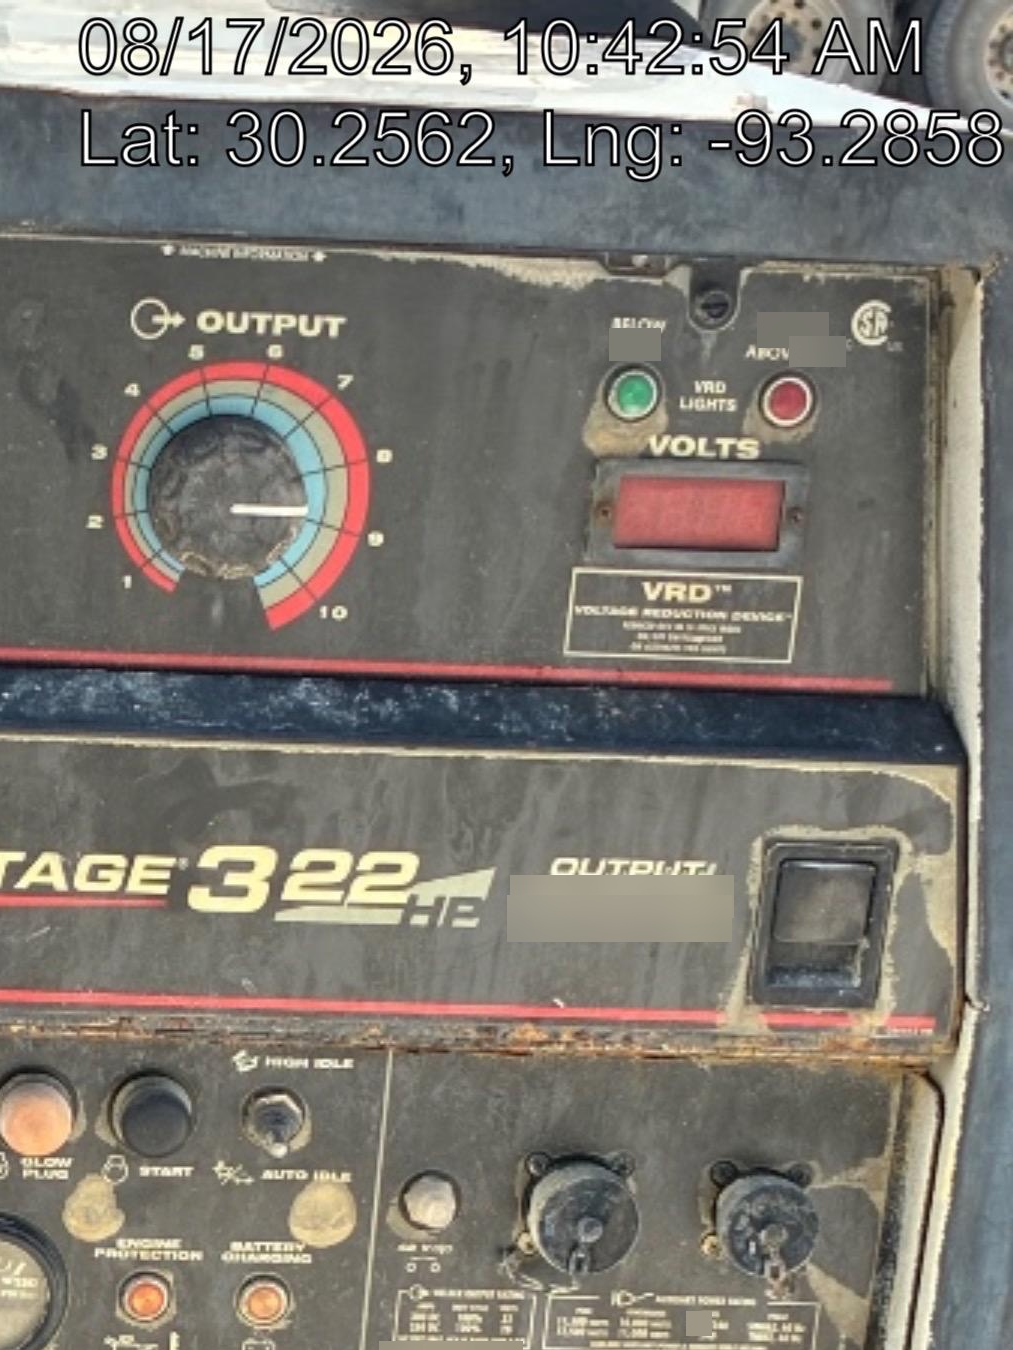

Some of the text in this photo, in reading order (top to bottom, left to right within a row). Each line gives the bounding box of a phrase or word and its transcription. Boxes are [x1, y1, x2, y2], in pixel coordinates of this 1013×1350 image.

[196, 309, 346, 339] OUTPUT
[188, 344, 205, 361] 5
[267, 344, 284, 359] 6
[338, 375, 354, 390] 7
[694, 380, 727, 394] VRD
[124, 383, 141, 398] 4
[679, 396, 737, 412] LIGHTS
[91, 444, 108, 460] 3
[648, 434, 760, 460] VOLTS
[376, 448, 393, 464] 8
[87, 515, 104, 529] 2
[368, 532, 384, 547] 9
[122, 575, 132, 588] 1
[319, 605, 348, 620] 10
[265, 1056, 354, 1070] HIGH IDLE
[22, 1168, 70, 1180] PLUG
[139, 1165, 195, 1178] START
[261, 1168, 352, 1183] AUTO IDLE
[115, 1238, 183, 1249] ENGINE
[229, 1241, 306, 1253] BATTERY
[93, 1248, 204, 1261] PROTECTION
[220, 1251, 313, 1265] CHARGING
